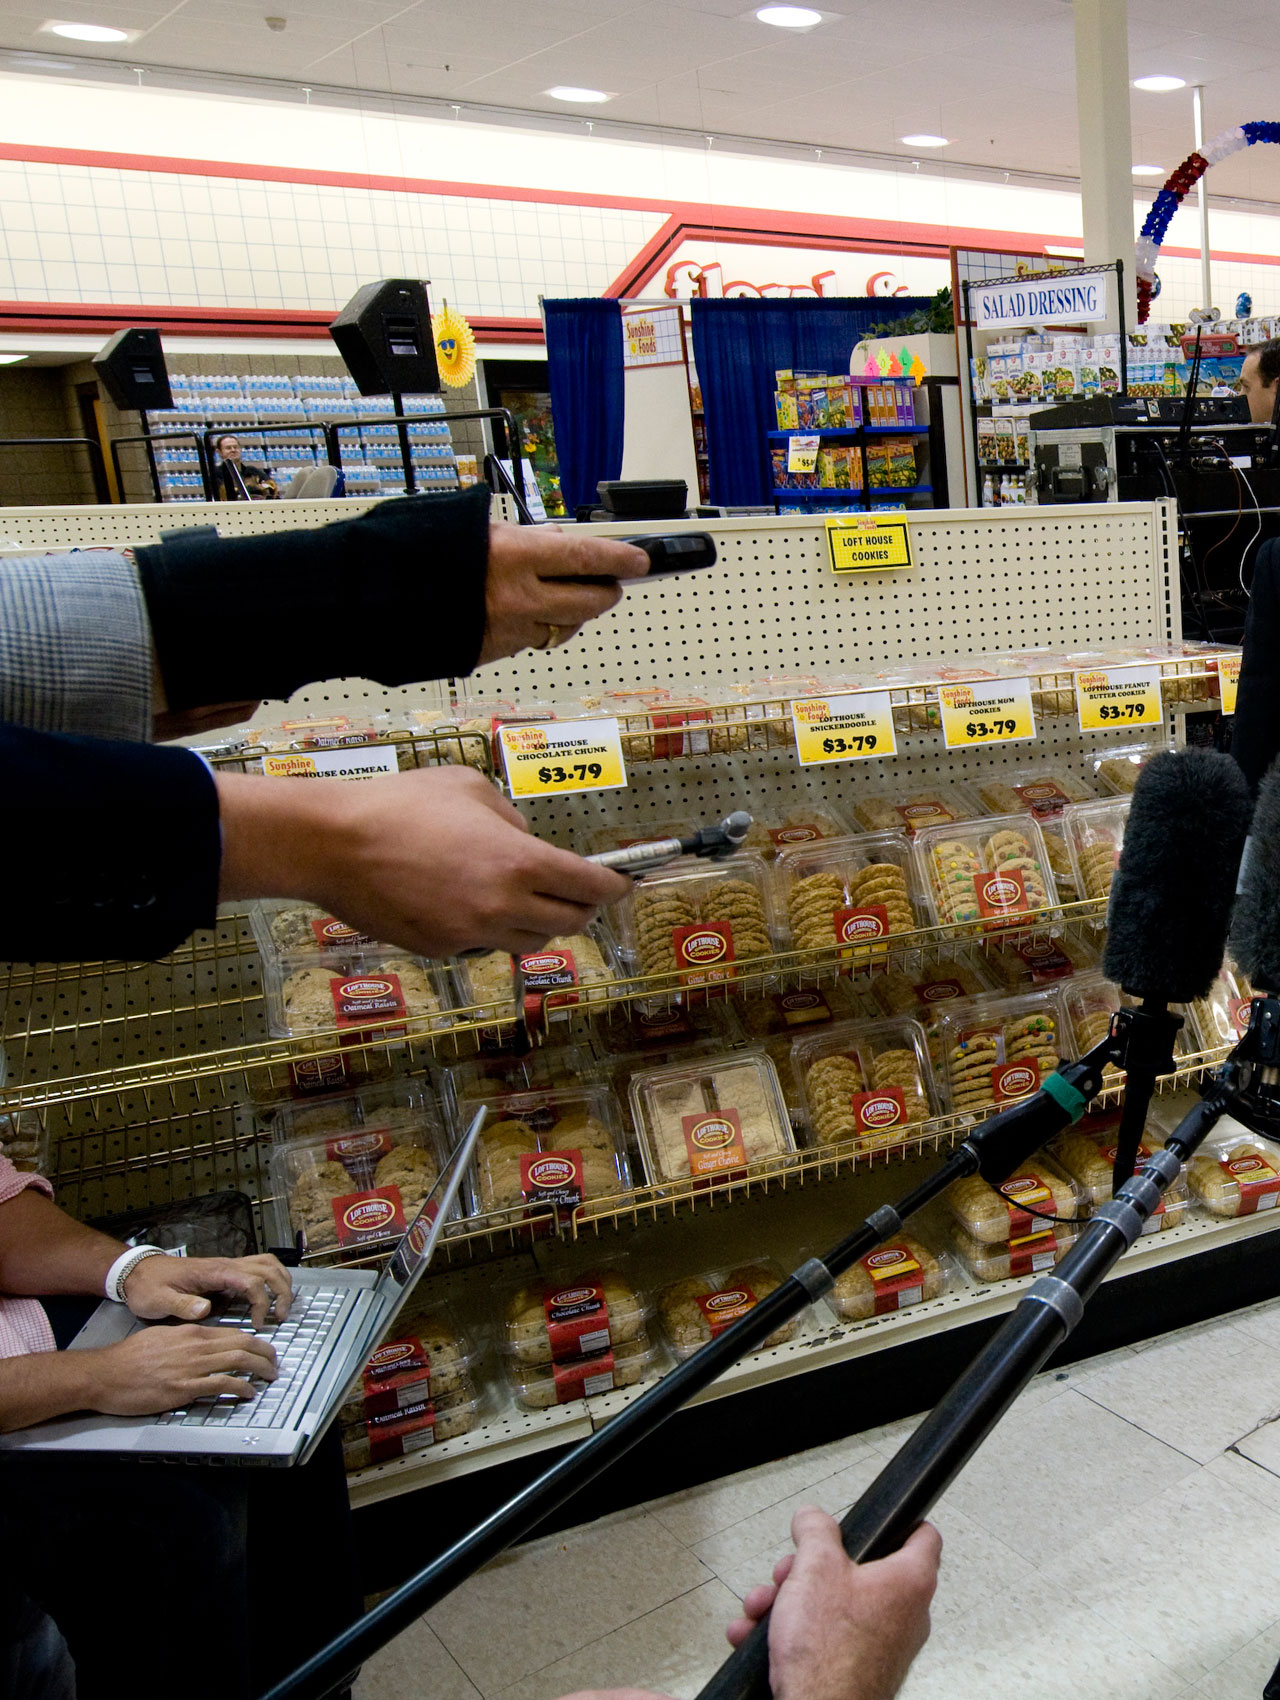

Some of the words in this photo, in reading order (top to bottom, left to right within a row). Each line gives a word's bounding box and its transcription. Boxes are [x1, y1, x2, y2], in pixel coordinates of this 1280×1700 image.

[983, 291, 1025, 320] SALAD
[1028, 285, 1097, 316] DRESSING
[627, 321, 655, 339] Sunshine
[638, 339, 656, 353] Foods
[842, 537, 863, 546] LOFT
[865, 535, 893, 545] HOUSE
[852, 551, 889, 561] COOKIES
[1083, 684, 1123, 693] LOFTHOUSE
[1124, 682, 1151, 690] PEANUT
[1089, 692, 1117, 700] BUTTER
[1117, 689, 1146, 697] COOKIES
[795, 703, 827, 713] Sunshine
[954, 699, 997, 709] LOFTHOUSE
[969, 707, 1001, 715] COOKIES
[1099, 703, 1146, 720] $3.79
[819, 713, 866, 723] LOFTHOUSE
[810, 720, 877, 732] SNICKERDOODLE
[966, 719, 1016, 737] $3.79
[506, 731, 543, 743] Sunshine
[534, 739, 588, 751] LOFTHOUSE
[823, 735, 877, 754] $3.79
[517, 748, 573, 761] CHOCOLATE
[575, 746, 608, 756] CHUNK
[269, 759, 312, 772] Sunshine
[339, 765, 390, 776] OATMEAL
[538, 763, 602, 784] $3.79
[847, 916, 878, 935] LOFTHOUSE
[849, 931, 878, 939] COOKIES
[687, 937, 721, 952] LOFTHOUSE
[690, 948, 720, 957] COOKIES
[525, 977, 551, 986] hocolate
[551, 974, 573, 984] Chunk
[343, 1003, 373, 1012] Oatmeal
[865, 1102, 896, 1117] LOFTHOUSE
[697, 1124, 729, 1139] LOFTHOUSE
[534, 1163, 569, 1176] LOFTHOUSE
[698, 1160, 717, 1171] Ginger
[536, 1173, 568, 1181] COOKIES
[350, 1203, 389, 1221] LOFTHOUSE
[353, 1214, 388, 1226] COOKIES
[551, 1306, 581, 1319] Chocolate
[581, 1303, 601, 1314] Chunk
